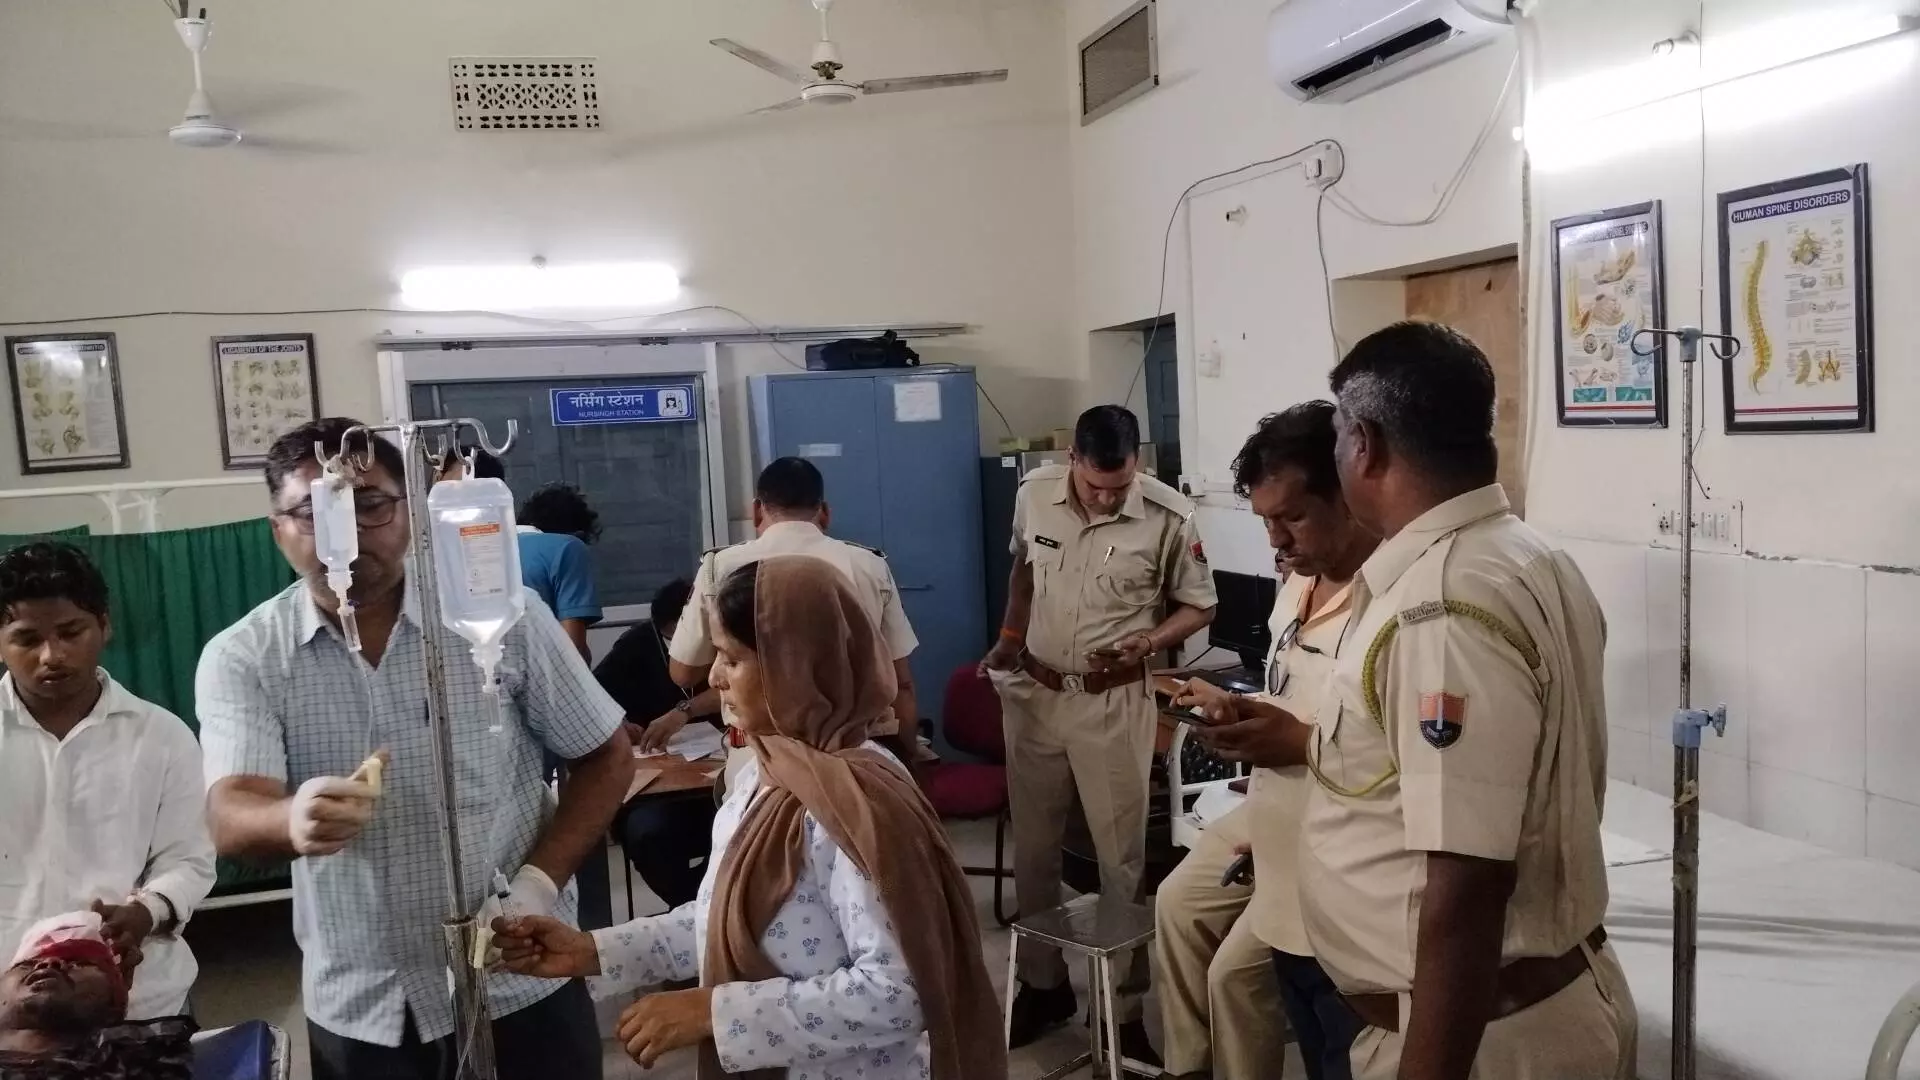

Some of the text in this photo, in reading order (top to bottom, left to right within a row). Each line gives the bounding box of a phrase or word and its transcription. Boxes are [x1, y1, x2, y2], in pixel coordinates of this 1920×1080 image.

[1733, 191, 1849, 221] HUMAN SPINE DISORDERS
[569, 391, 644, 408] नर्सिंग स्टेशन
[616, 409, 644, 417] STATION
